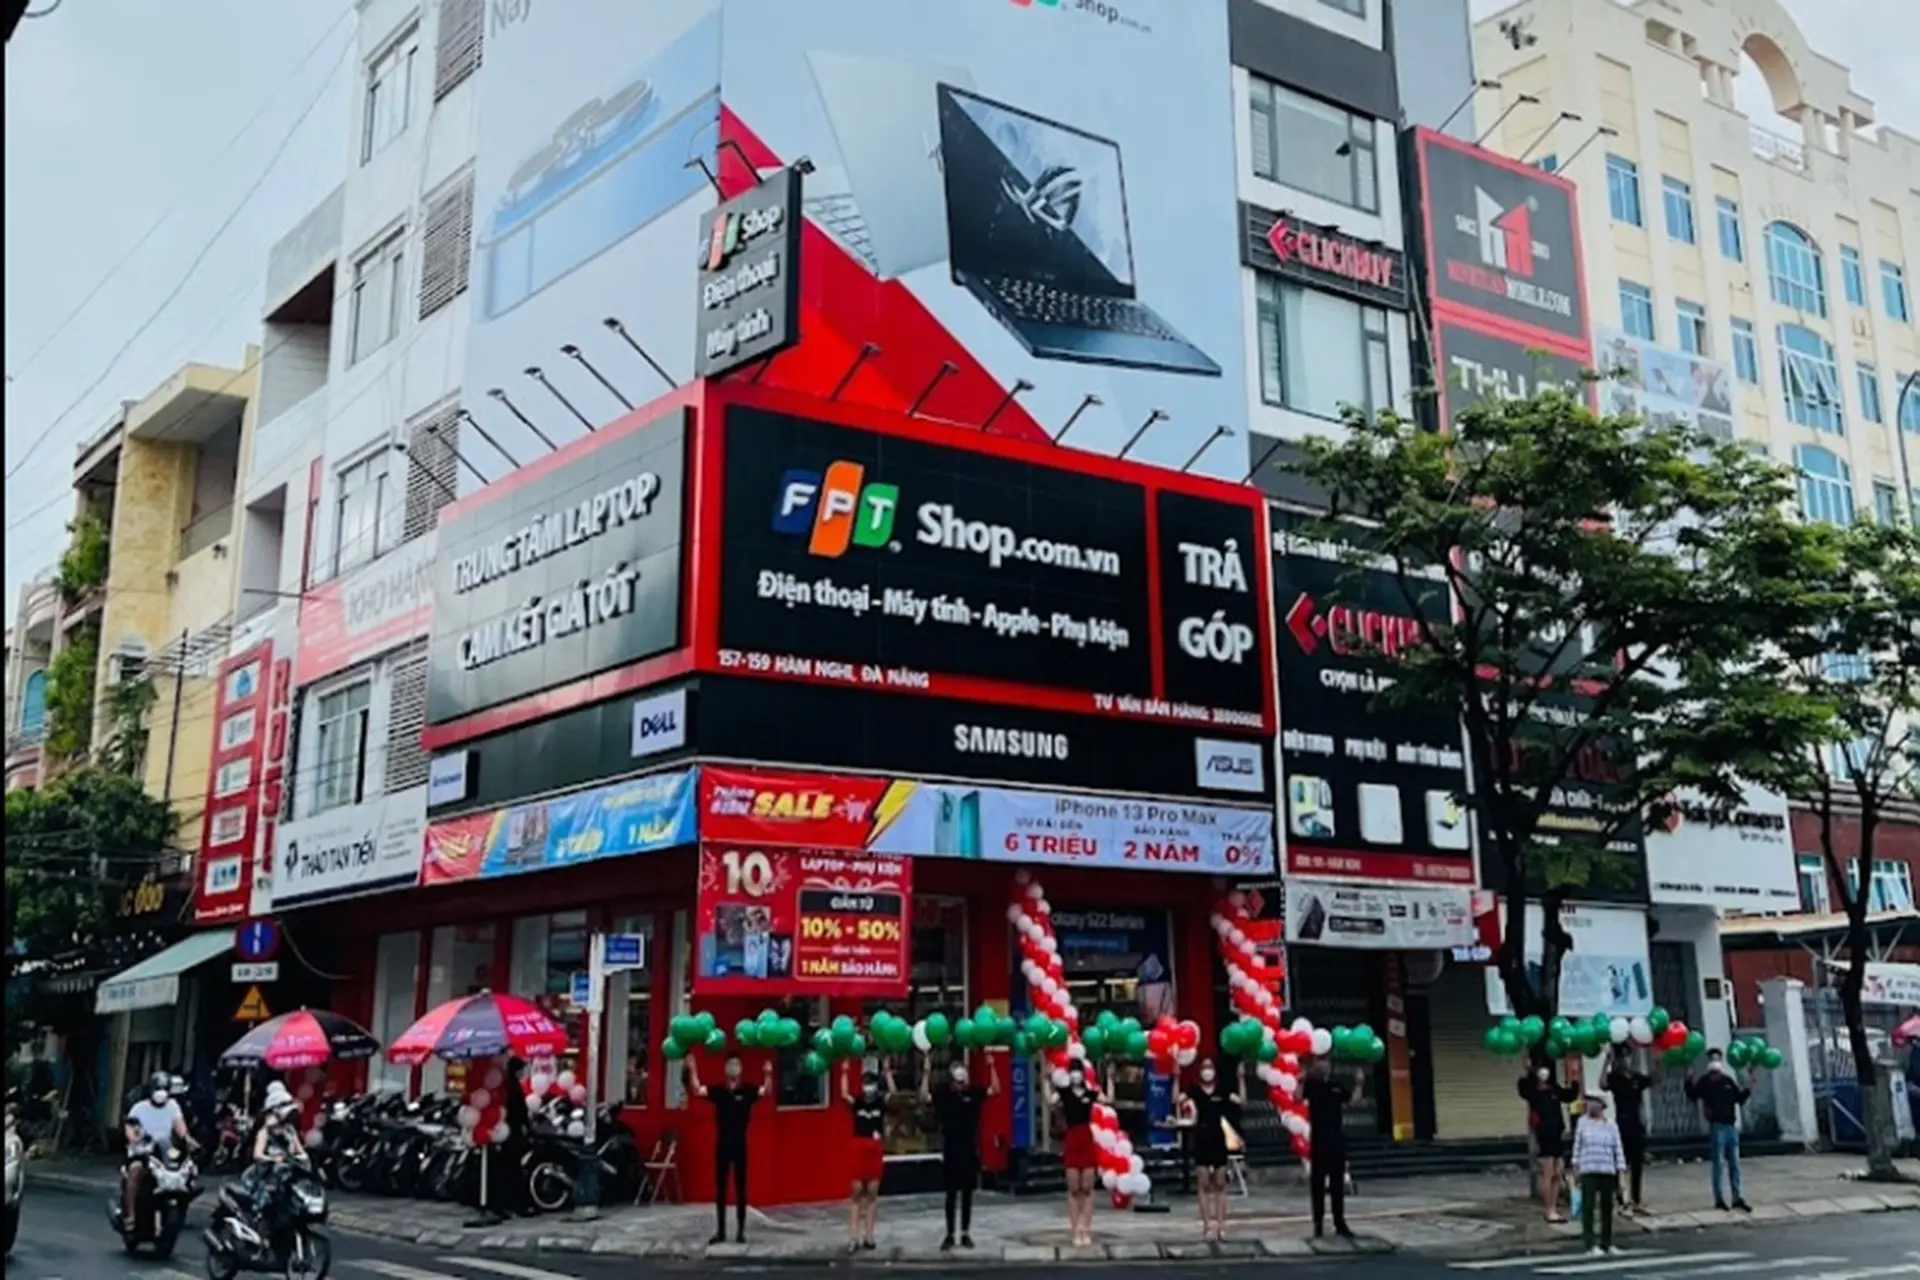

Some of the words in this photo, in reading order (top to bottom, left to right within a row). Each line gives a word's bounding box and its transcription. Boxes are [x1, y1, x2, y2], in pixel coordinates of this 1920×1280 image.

[1298, 231, 1392, 288] CLICKBUY
[452, 534, 520, 595] TRUNG
[518, 512, 562, 566] TÂM
[565, 472, 661, 548] LAPTOP
[916, 502, 1120, 576] Shop.com.vn
[1177, 539, 1248, 592] TRẢ
[588, 562, 641, 622] TỐT
[757, 569, 811, 609] Điện
[813, 577, 870, 618] thoại
[883, 587, 928, 626] Máy
[931, 594, 971, 625] tính
[983, 603, 1041, 638] Apple
[1051, 612, 1087, 648] Phụ
[1088, 617, 1129, 652] kiện
[1177, 610, 1254, 664] GÓP
[718, 649, 771, 671] 157-159
[640, 711, 677, 738] DELL
[954, 723, 1069, 760] SAMSUNG
[754, 791, 834, 819] SALE
[1055, 797, 1119, 819] iPhone
[1123, 805, 1143, 821] 13
[1147, 807, 1180, 825] Pro
[1182, 811, 1218, 826] Max
[1005, 833, 1019, 852] 6
[1027, 833, 1098, 860] TRIỆU
[1123, 840, 1138, 860] 2
[1144, 837, 1200, 863] NĂM
[723, 850, 774, 897] 10
[801, 916, 842, 938] 10%
[857, 918, 900, 941] 50%
